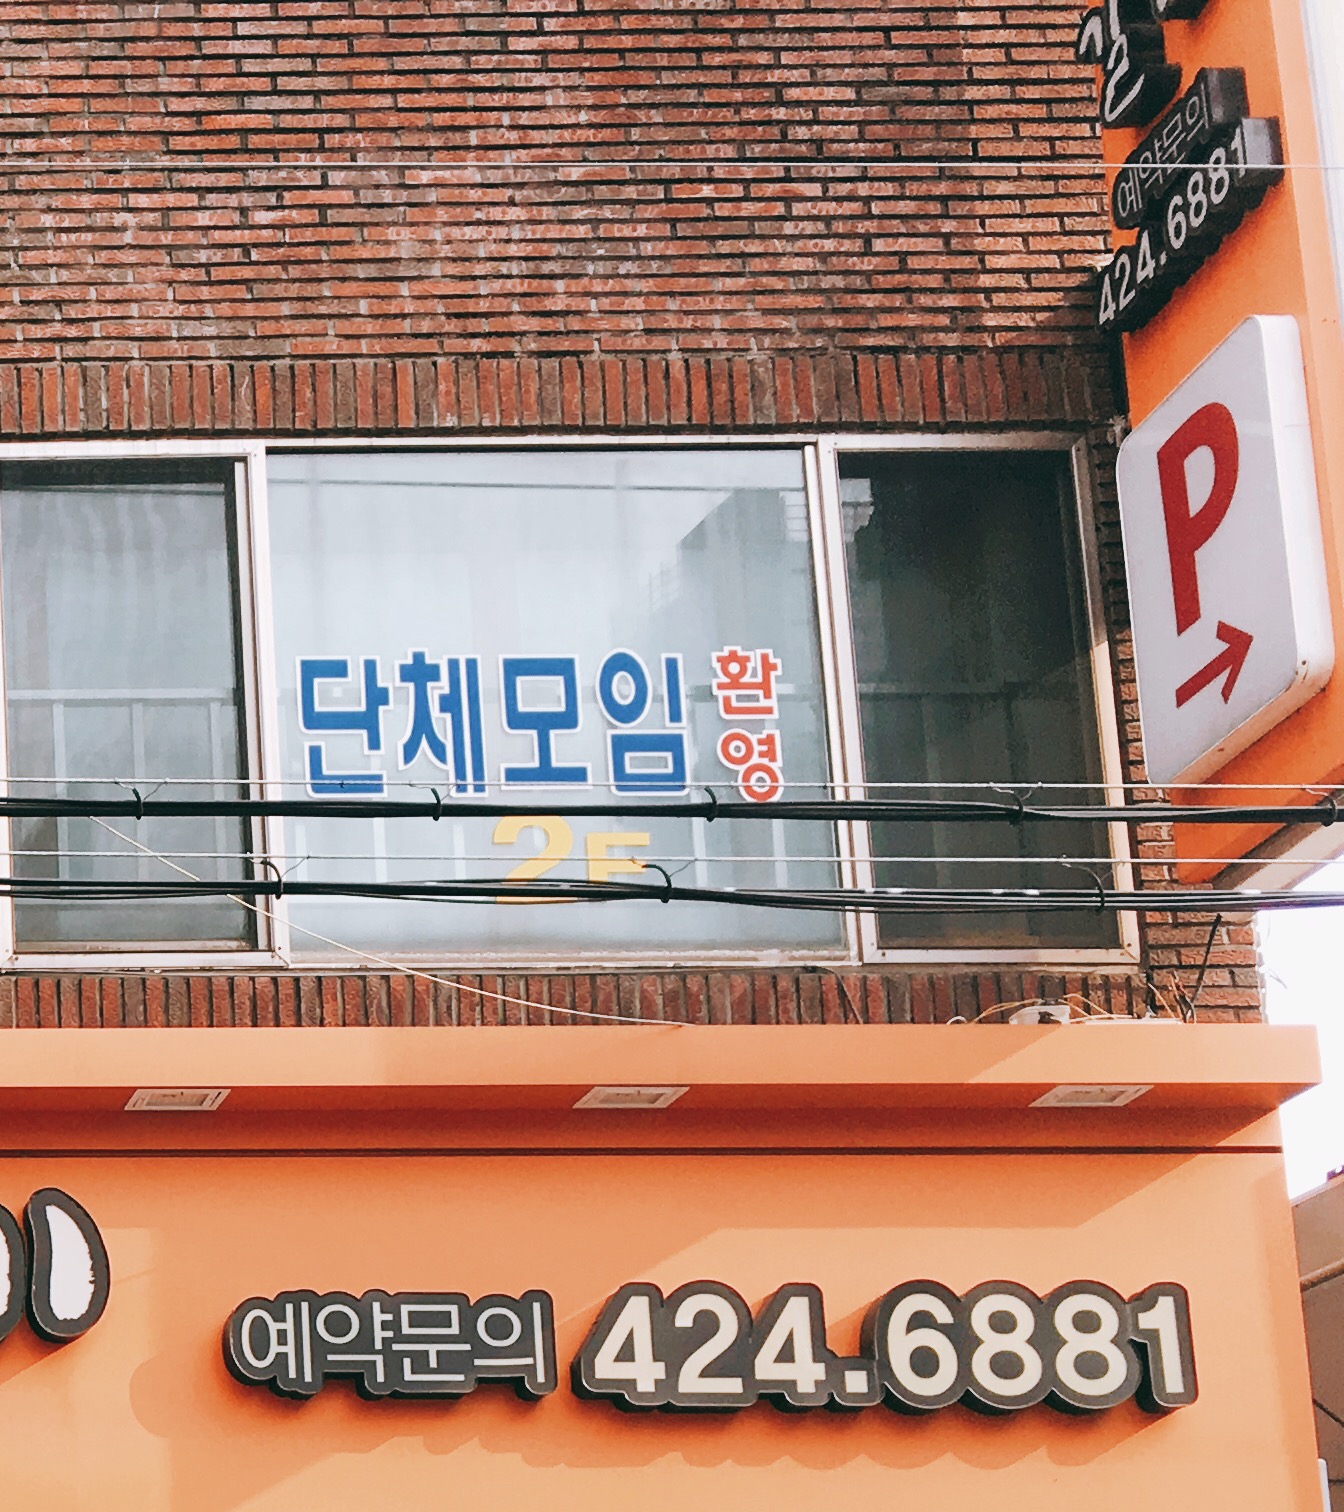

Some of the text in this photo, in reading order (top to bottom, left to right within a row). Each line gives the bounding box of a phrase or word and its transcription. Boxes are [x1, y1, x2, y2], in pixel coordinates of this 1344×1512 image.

[1098, 130, 1248, 326] 424.6881
[1117, 83, 1210, 219] 예약문의
[1156, 401, 1240, 637] P
[295, 644, 785, 803] 단체모임 환영
[238, 1299, 548, 1390] 예약문의
[592, 1289, 1188, 1400] 424.6881
